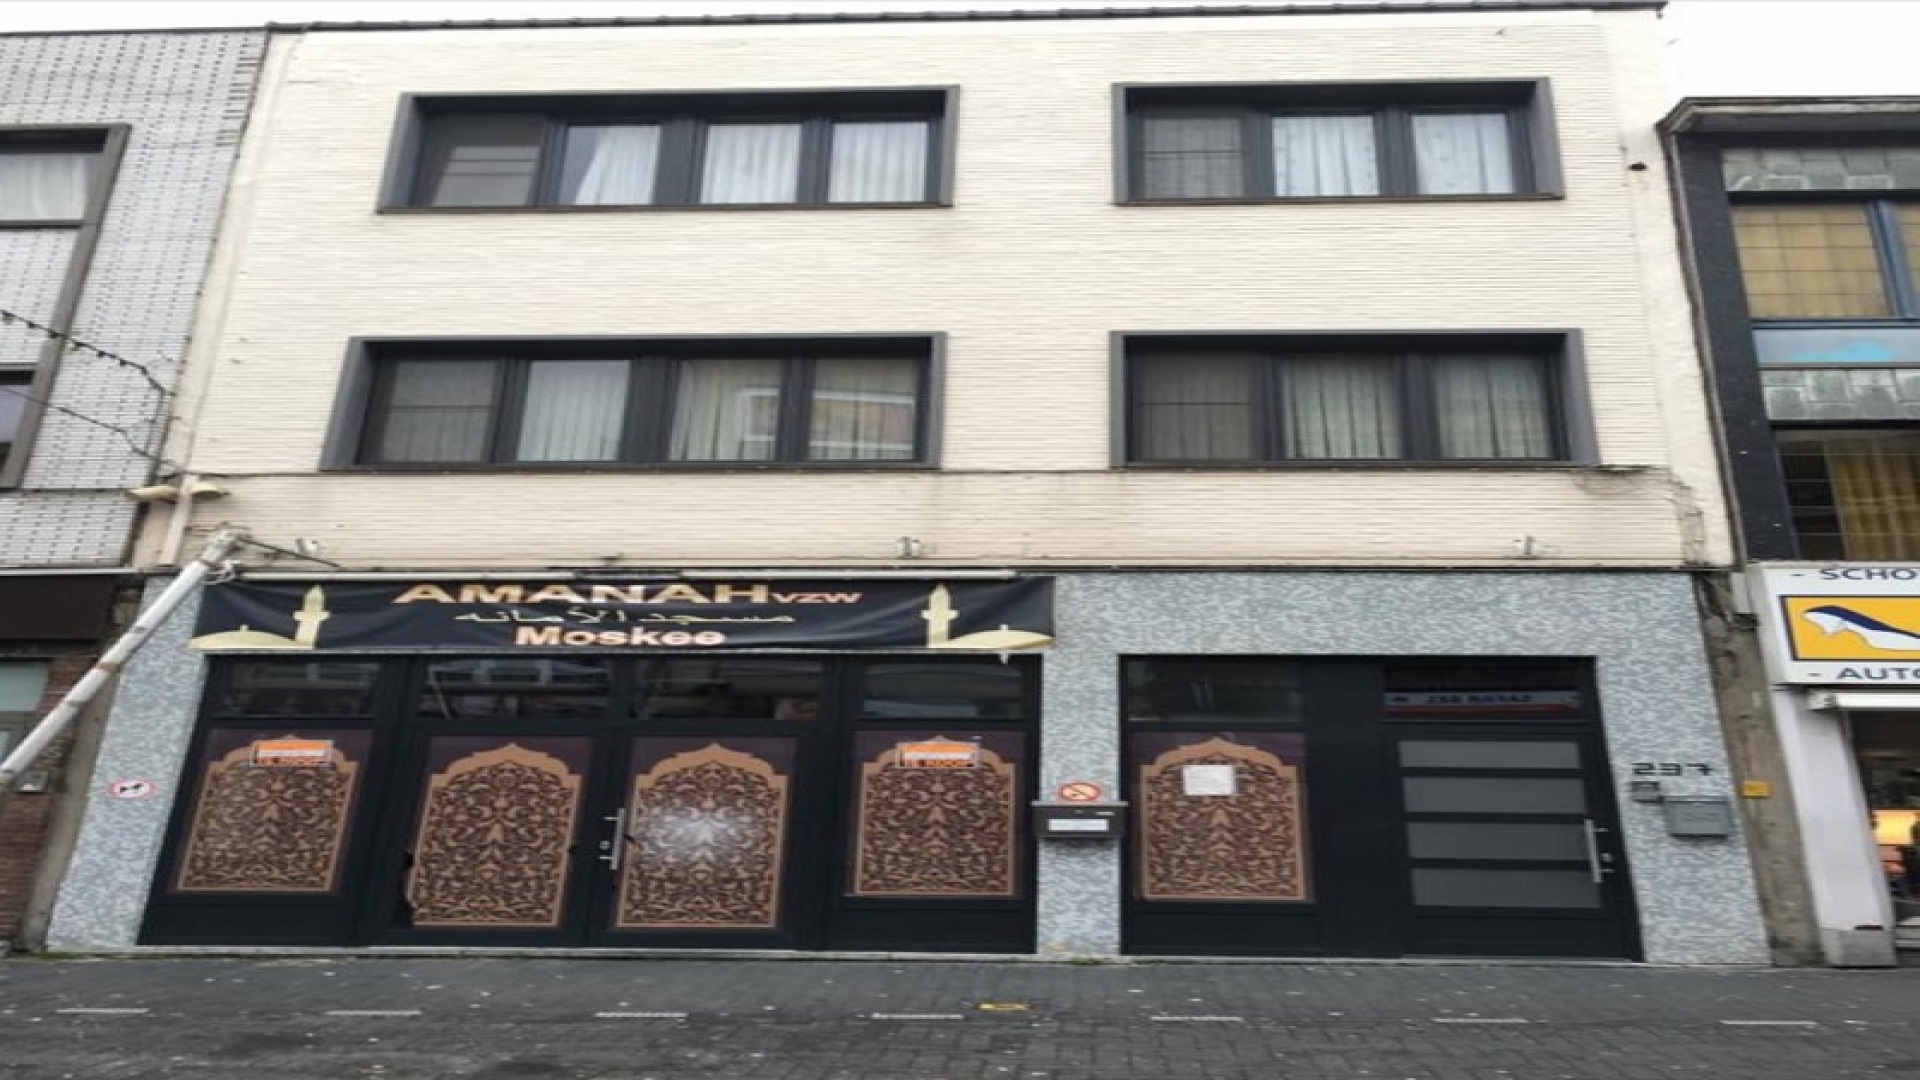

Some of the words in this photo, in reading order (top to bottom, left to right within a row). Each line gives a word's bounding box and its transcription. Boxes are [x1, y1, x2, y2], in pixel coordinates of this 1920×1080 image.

[392, 584, 769, 603] AMANAH
[515, 625, 726, 646] Moskee
[1836, 667, 1920, 680] AUT
[1630, 762, 1714, 776] 237
